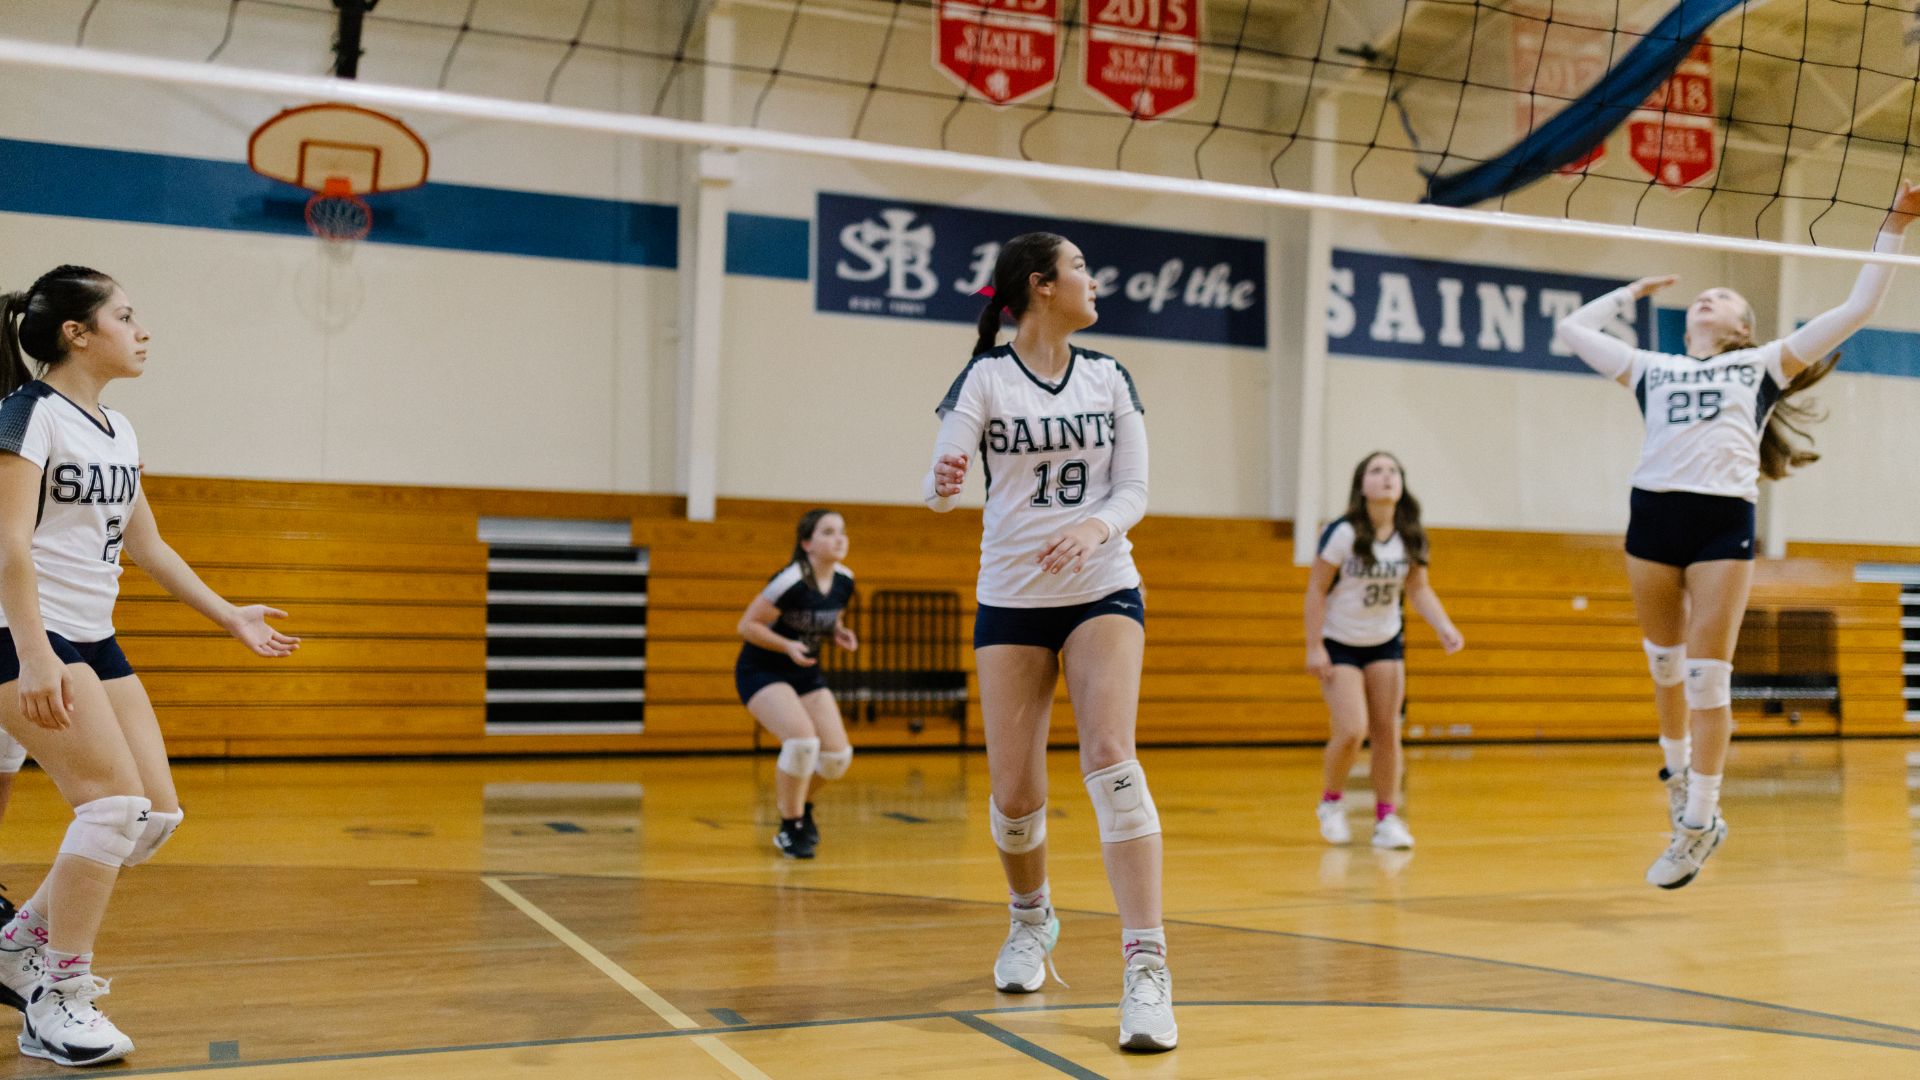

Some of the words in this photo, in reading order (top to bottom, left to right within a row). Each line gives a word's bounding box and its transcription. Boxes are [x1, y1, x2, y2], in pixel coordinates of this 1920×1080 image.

[1125, 258, 1184, 313] of
[1183, 262, 1256, 311] the
[1668, 389, 1721, 424] 25
[1030, 459, 1089, 507] 19
